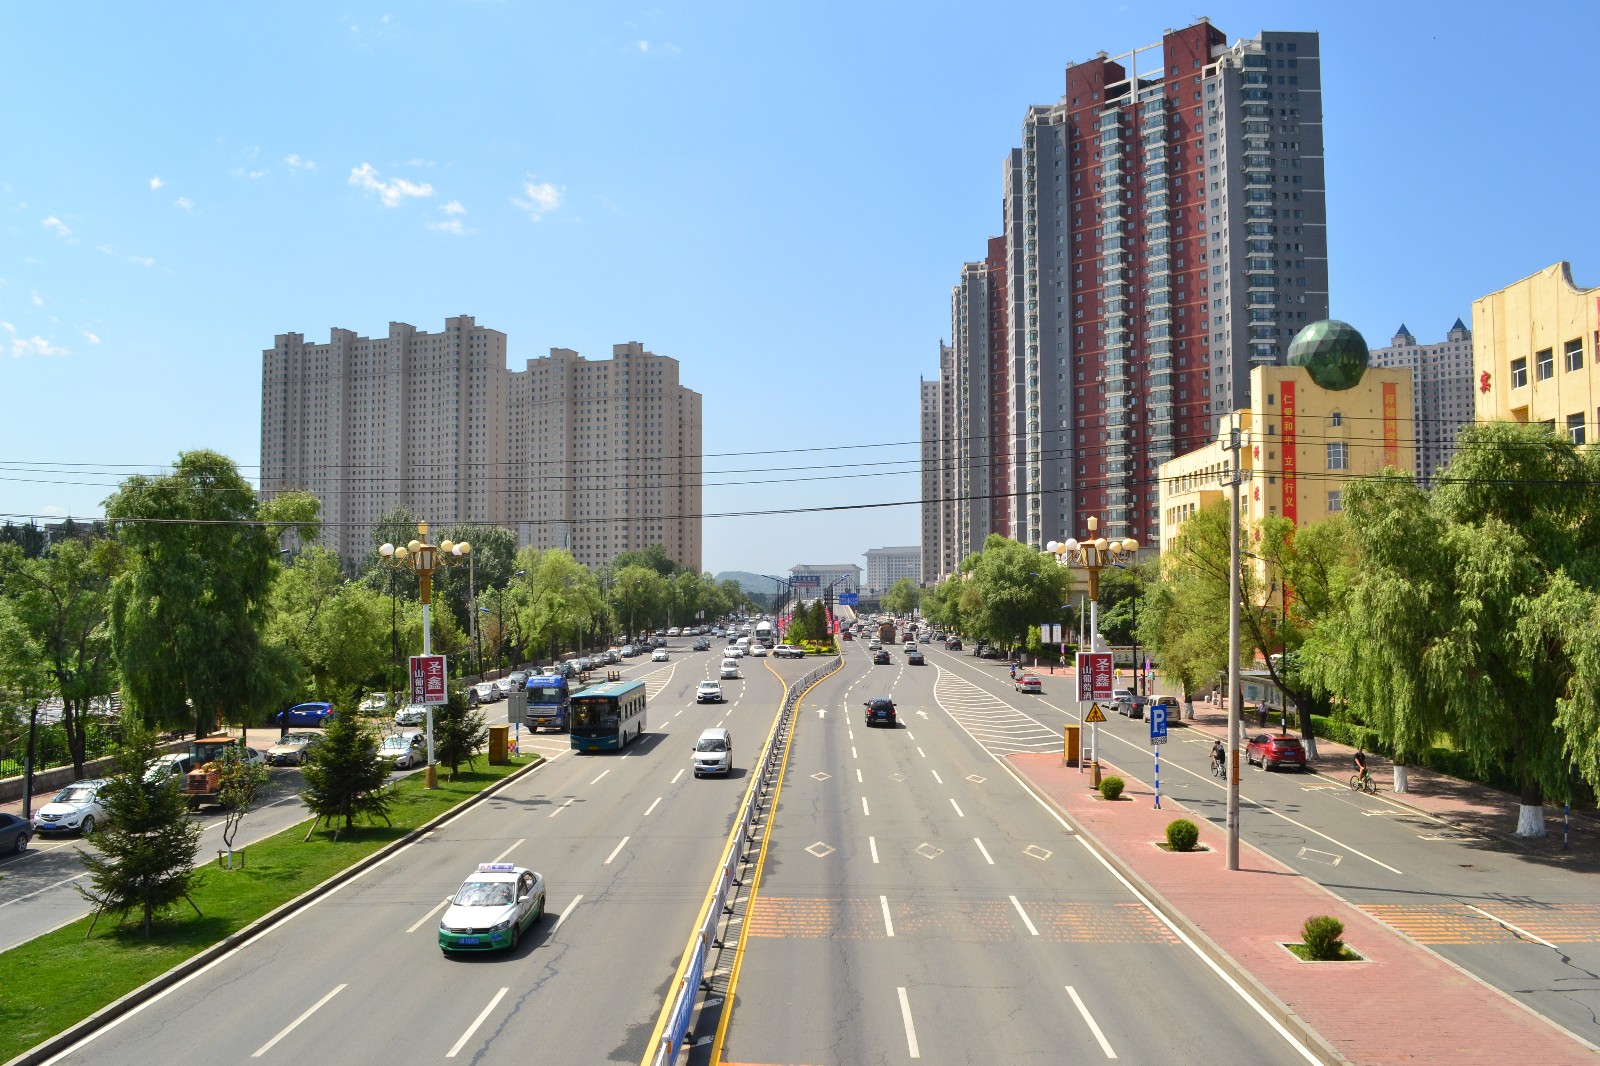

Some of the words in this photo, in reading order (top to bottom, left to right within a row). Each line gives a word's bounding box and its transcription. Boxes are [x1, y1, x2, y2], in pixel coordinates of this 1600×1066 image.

[414, 669, 424, 704] 山葡萄酒
[427, 661, 442, 690] 圣鑫
[1082, 665, 1092, 700] 山葡萄酒
[1095, 658, 1110, 687] 圣鑫
[1152, 709, 1165, 733] P
